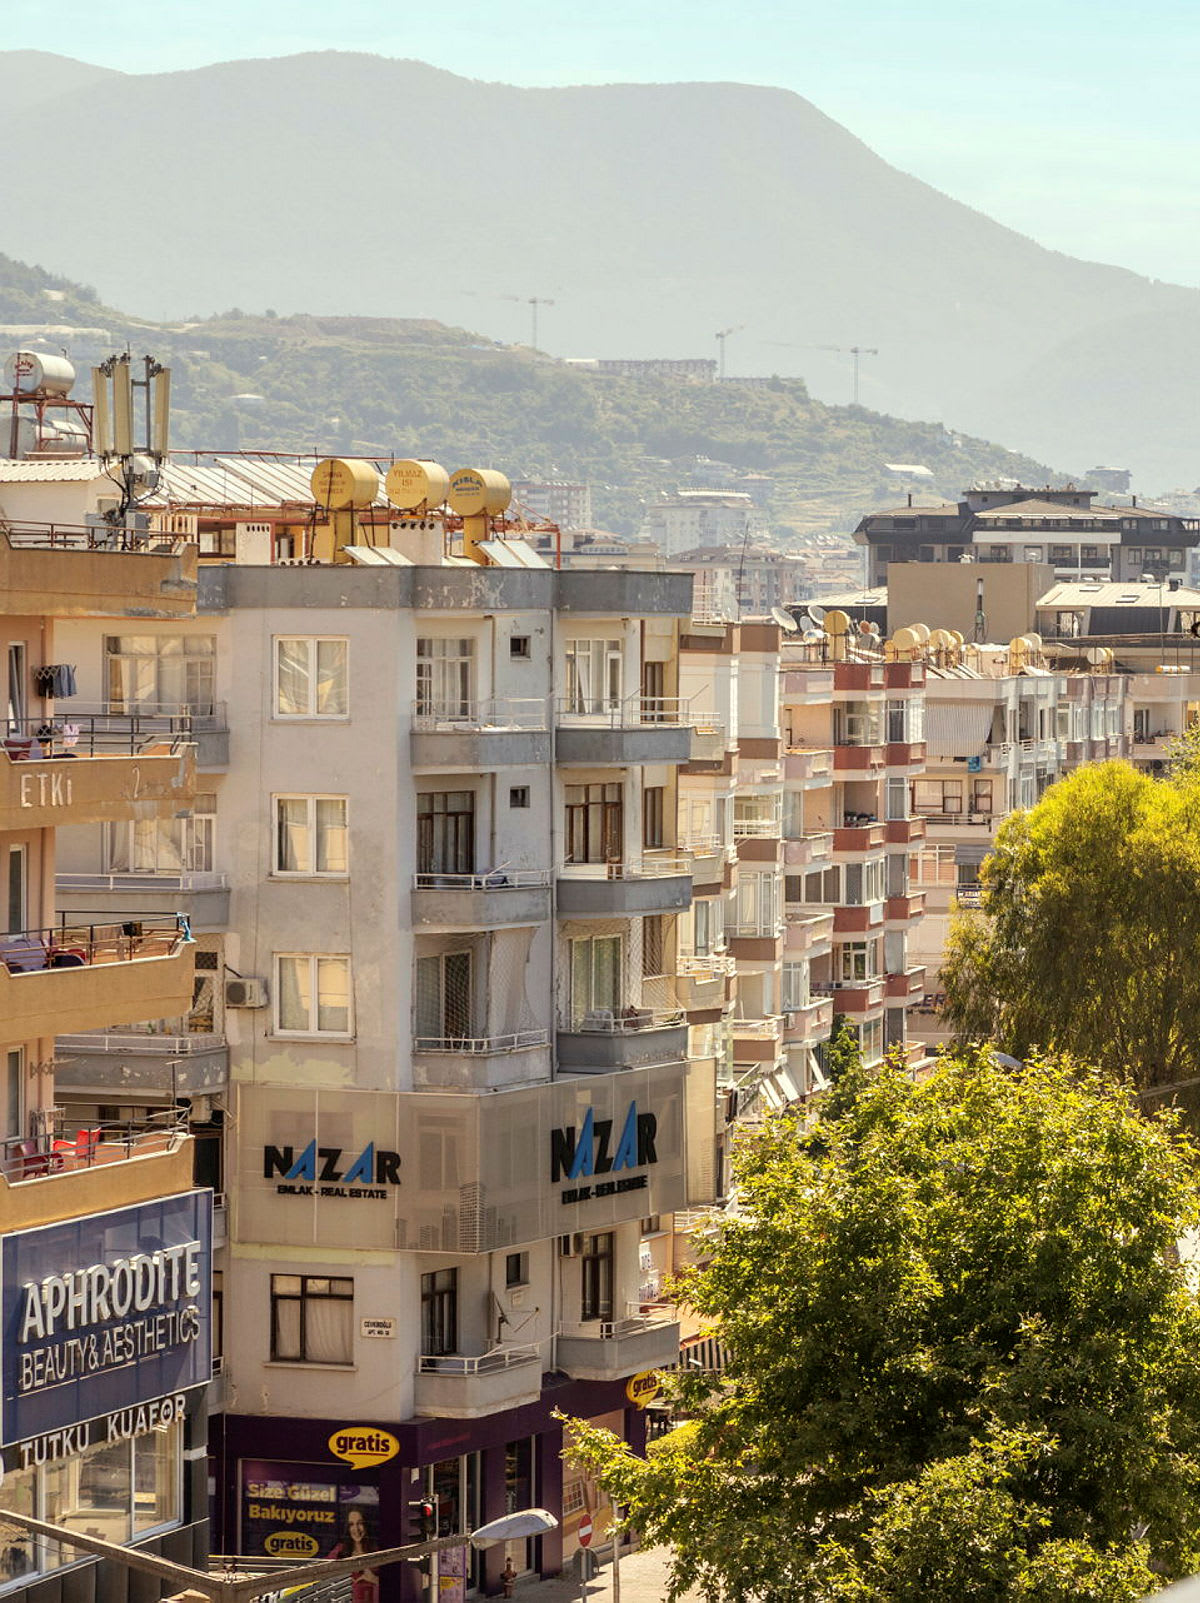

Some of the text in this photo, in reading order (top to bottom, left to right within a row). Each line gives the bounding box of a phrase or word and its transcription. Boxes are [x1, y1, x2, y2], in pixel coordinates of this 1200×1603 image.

[551, 1099, 659, 1183] NAZAR
[264, 1138, 402, 1185] NAZAR
[277, 1185, 313, 1196] EMLAK
[321, 1187, 347, 1198] REAL
[349, 1188, 388, 1199] ESTATE
[21, 1241, 201, 1344] APHRODITE
[633, 1373, 657, 1397] gratis
[20, 1423, 90, 1470] TUTKU
[336, 1432, 391, 1454] gratis
[248, 1484, 336, 1502] Size Güzel
[249, 1504, 337, 1524] Bakıyoruz
[270, 1536, 313, 1552] gratis
